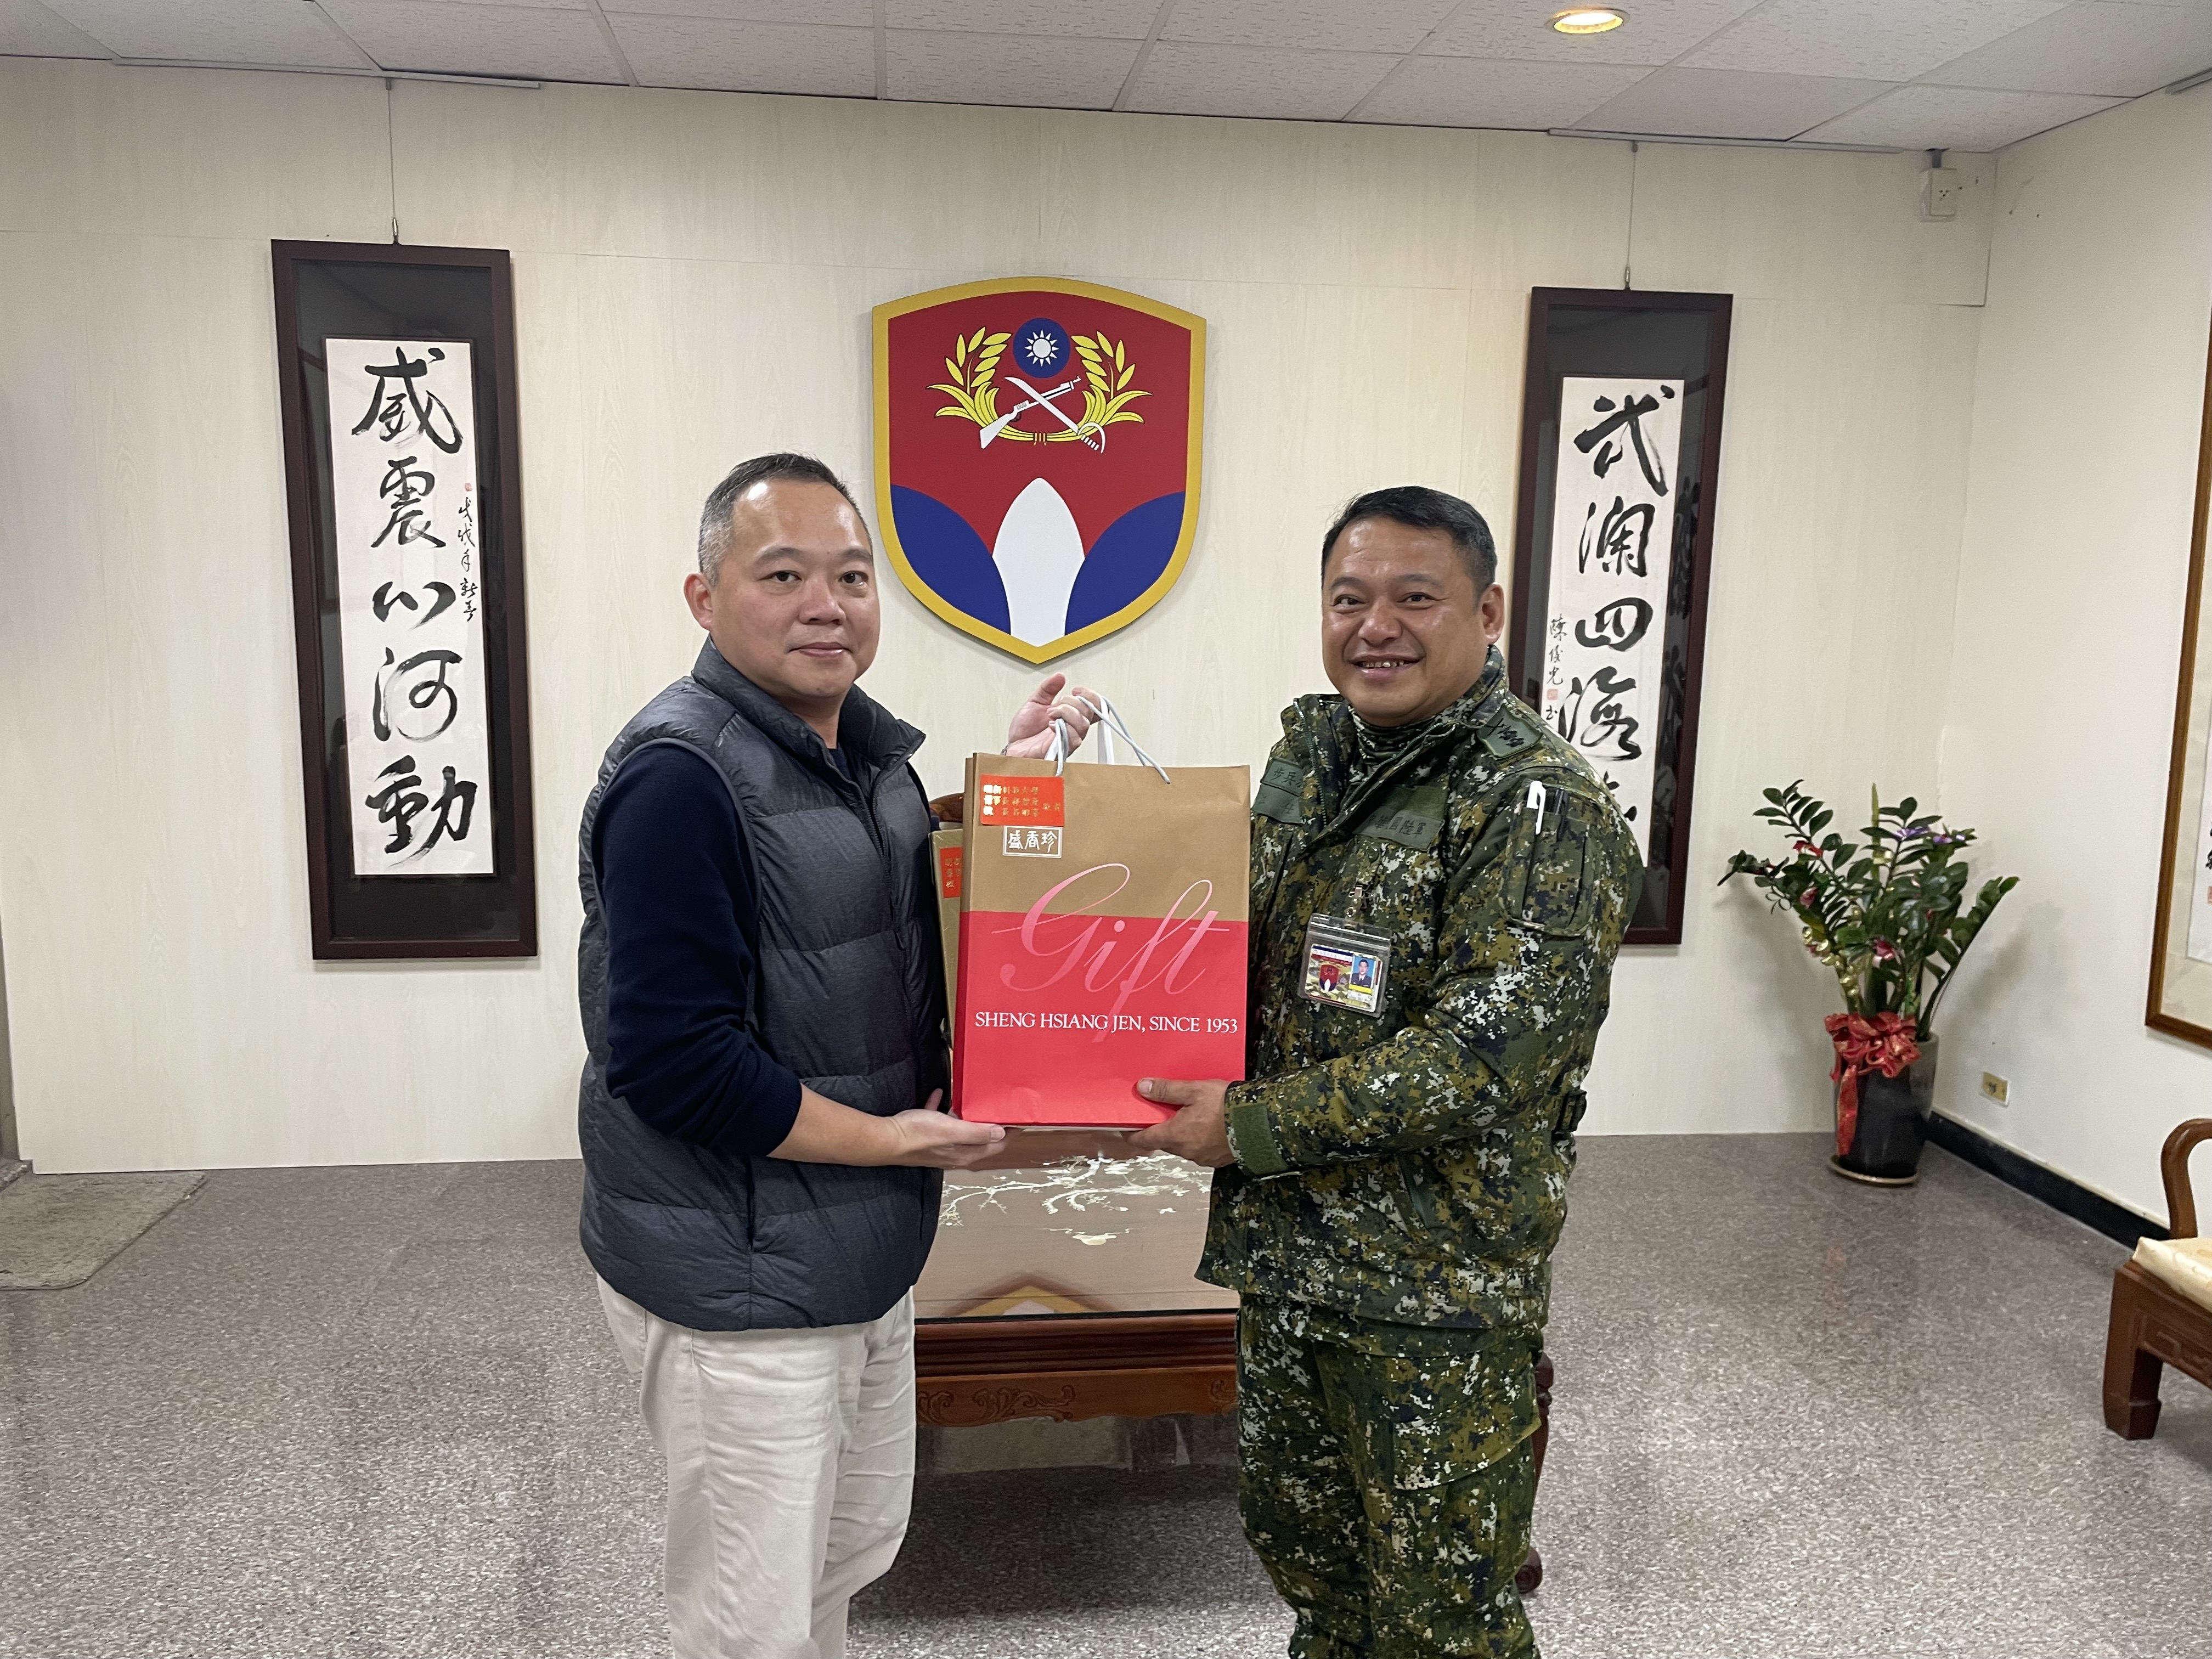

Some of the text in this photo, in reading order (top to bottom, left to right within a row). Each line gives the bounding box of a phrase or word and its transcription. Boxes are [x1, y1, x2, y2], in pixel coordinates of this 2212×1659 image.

[1007, 830, 1058, 853] 盛香珍
[991, 863, 1229, 1043] Gift
[975, 1012, 1238, 1034] SHENG HSIANG JEN, SINCE 1953
